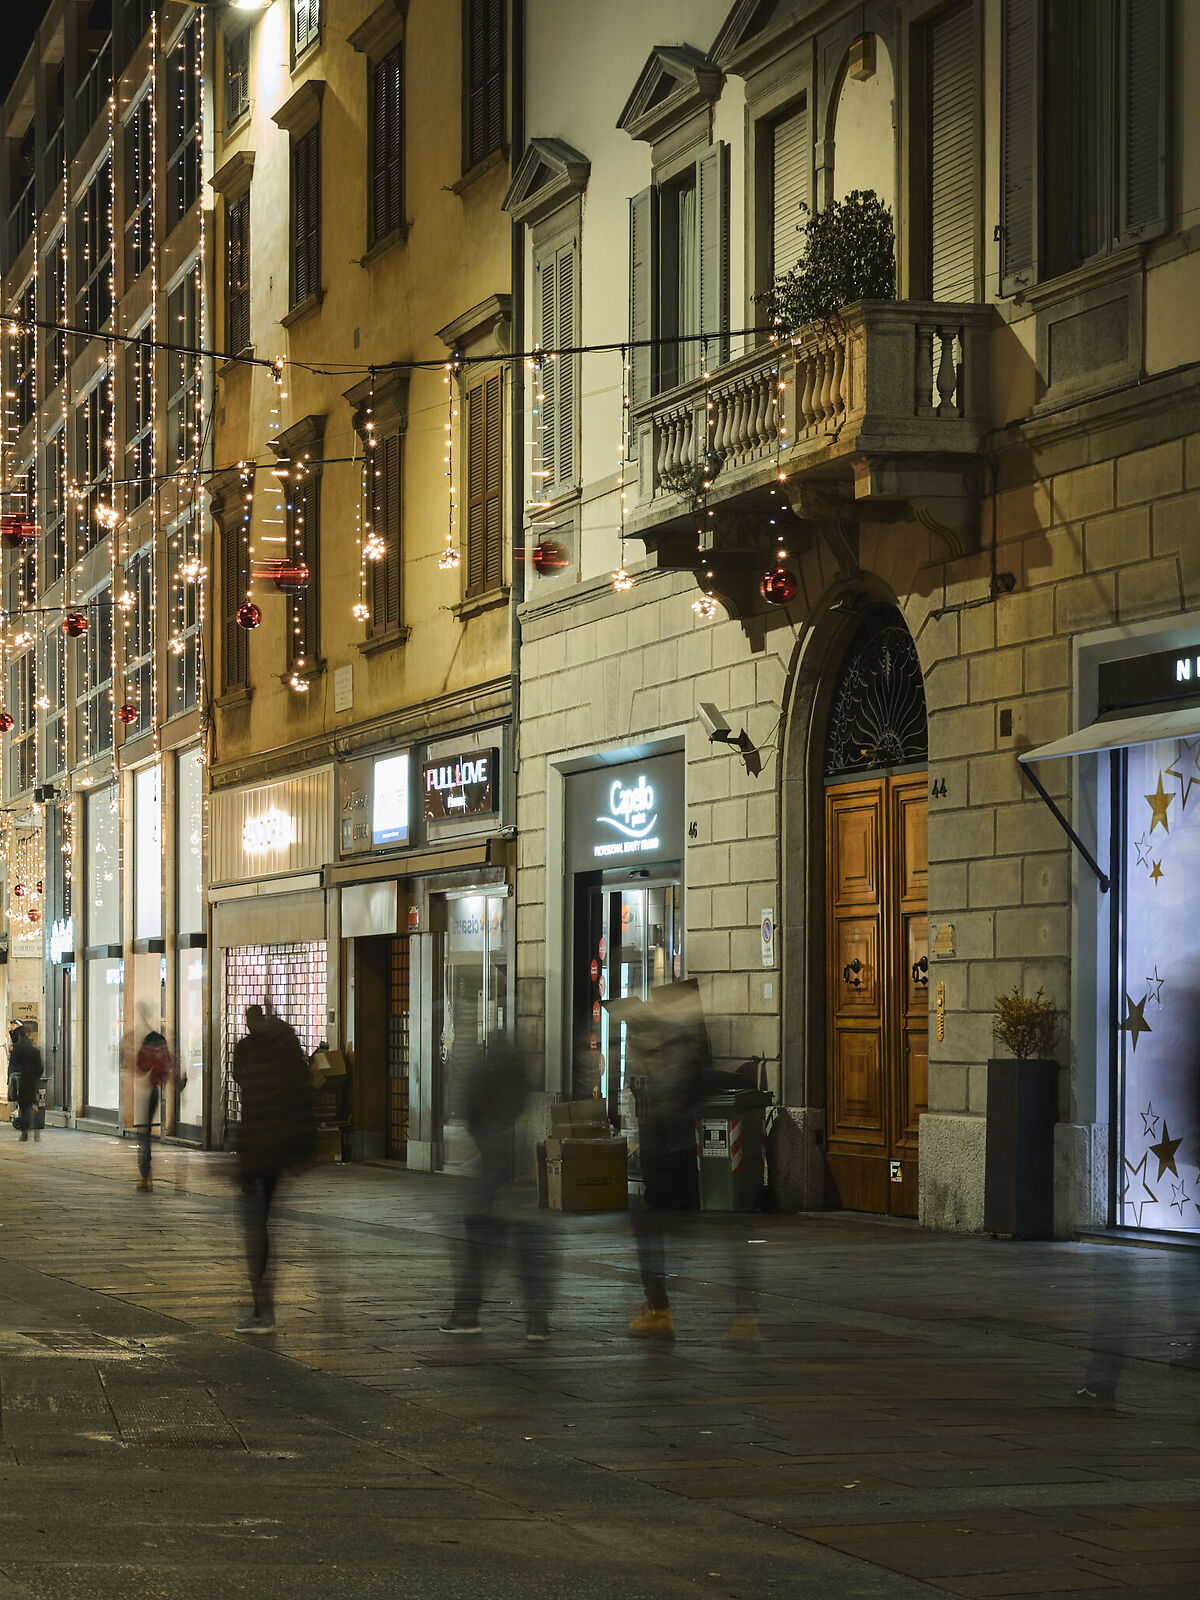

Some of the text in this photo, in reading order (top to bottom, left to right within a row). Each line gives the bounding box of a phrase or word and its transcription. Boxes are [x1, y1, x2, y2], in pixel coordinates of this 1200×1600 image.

[1176, 656, 1200, 681] N
[932, 777, 947, 798] 44
[610, 776, 654, 824] Capello
[688, 821, 698, 838] 46
